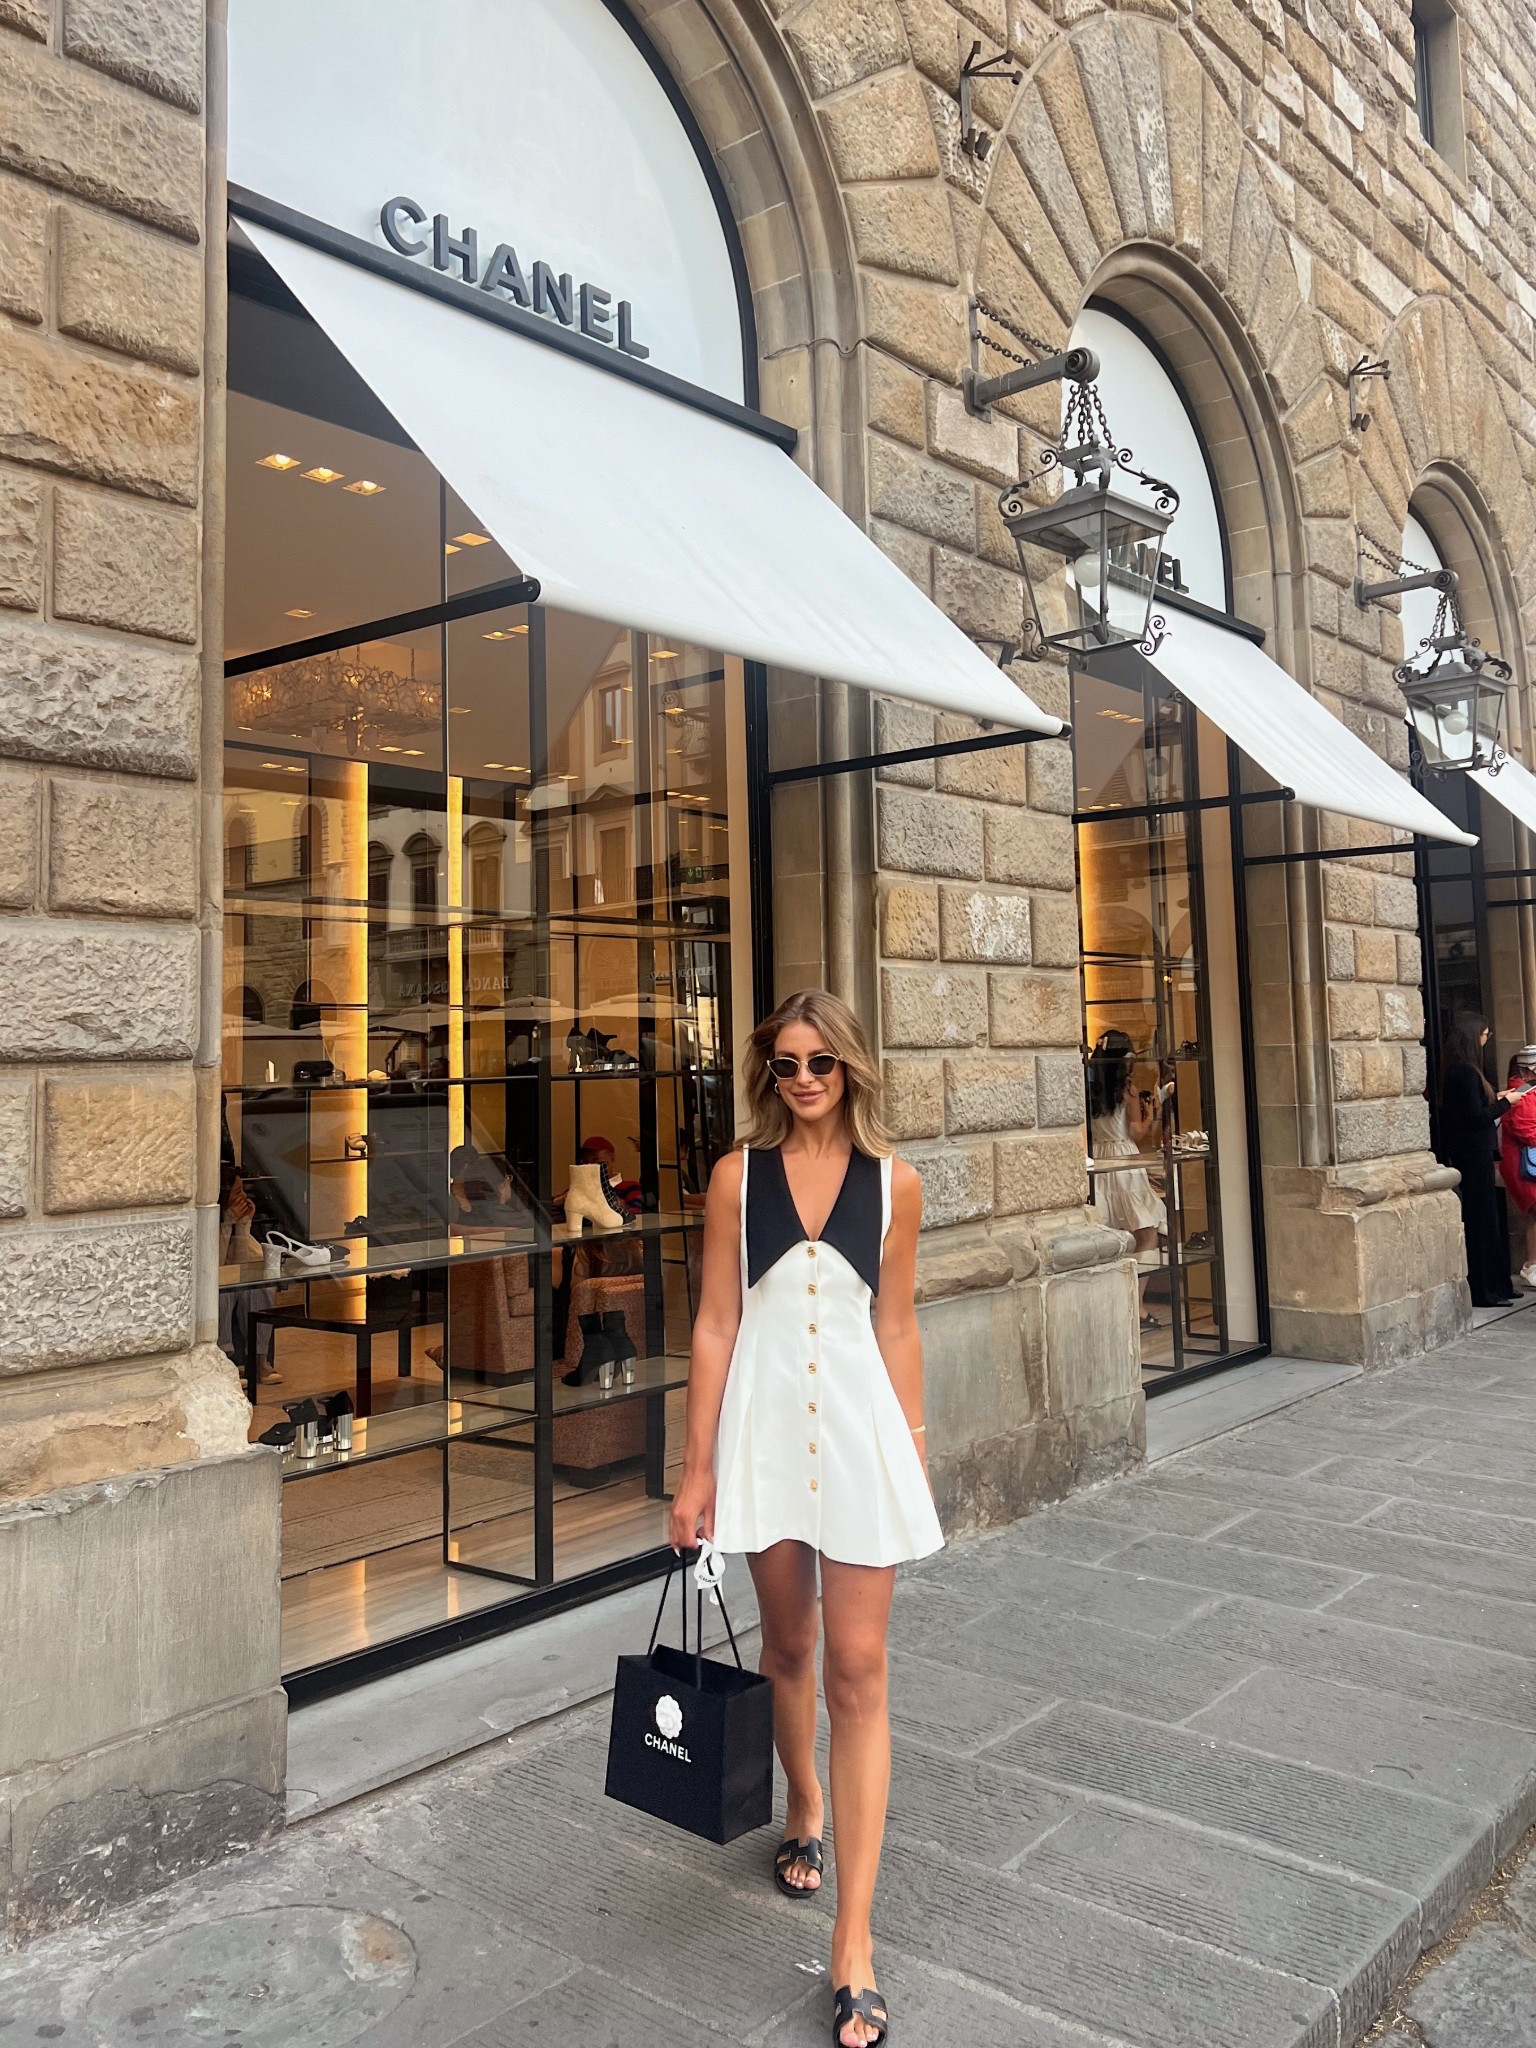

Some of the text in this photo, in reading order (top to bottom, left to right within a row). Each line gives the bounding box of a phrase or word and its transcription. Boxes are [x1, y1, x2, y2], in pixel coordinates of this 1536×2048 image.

[380, 196, 649, 360] CHANEL
[1110, 542, 1189, 594] ANEL
[644, 1733, 692, 1763] CHANEL
